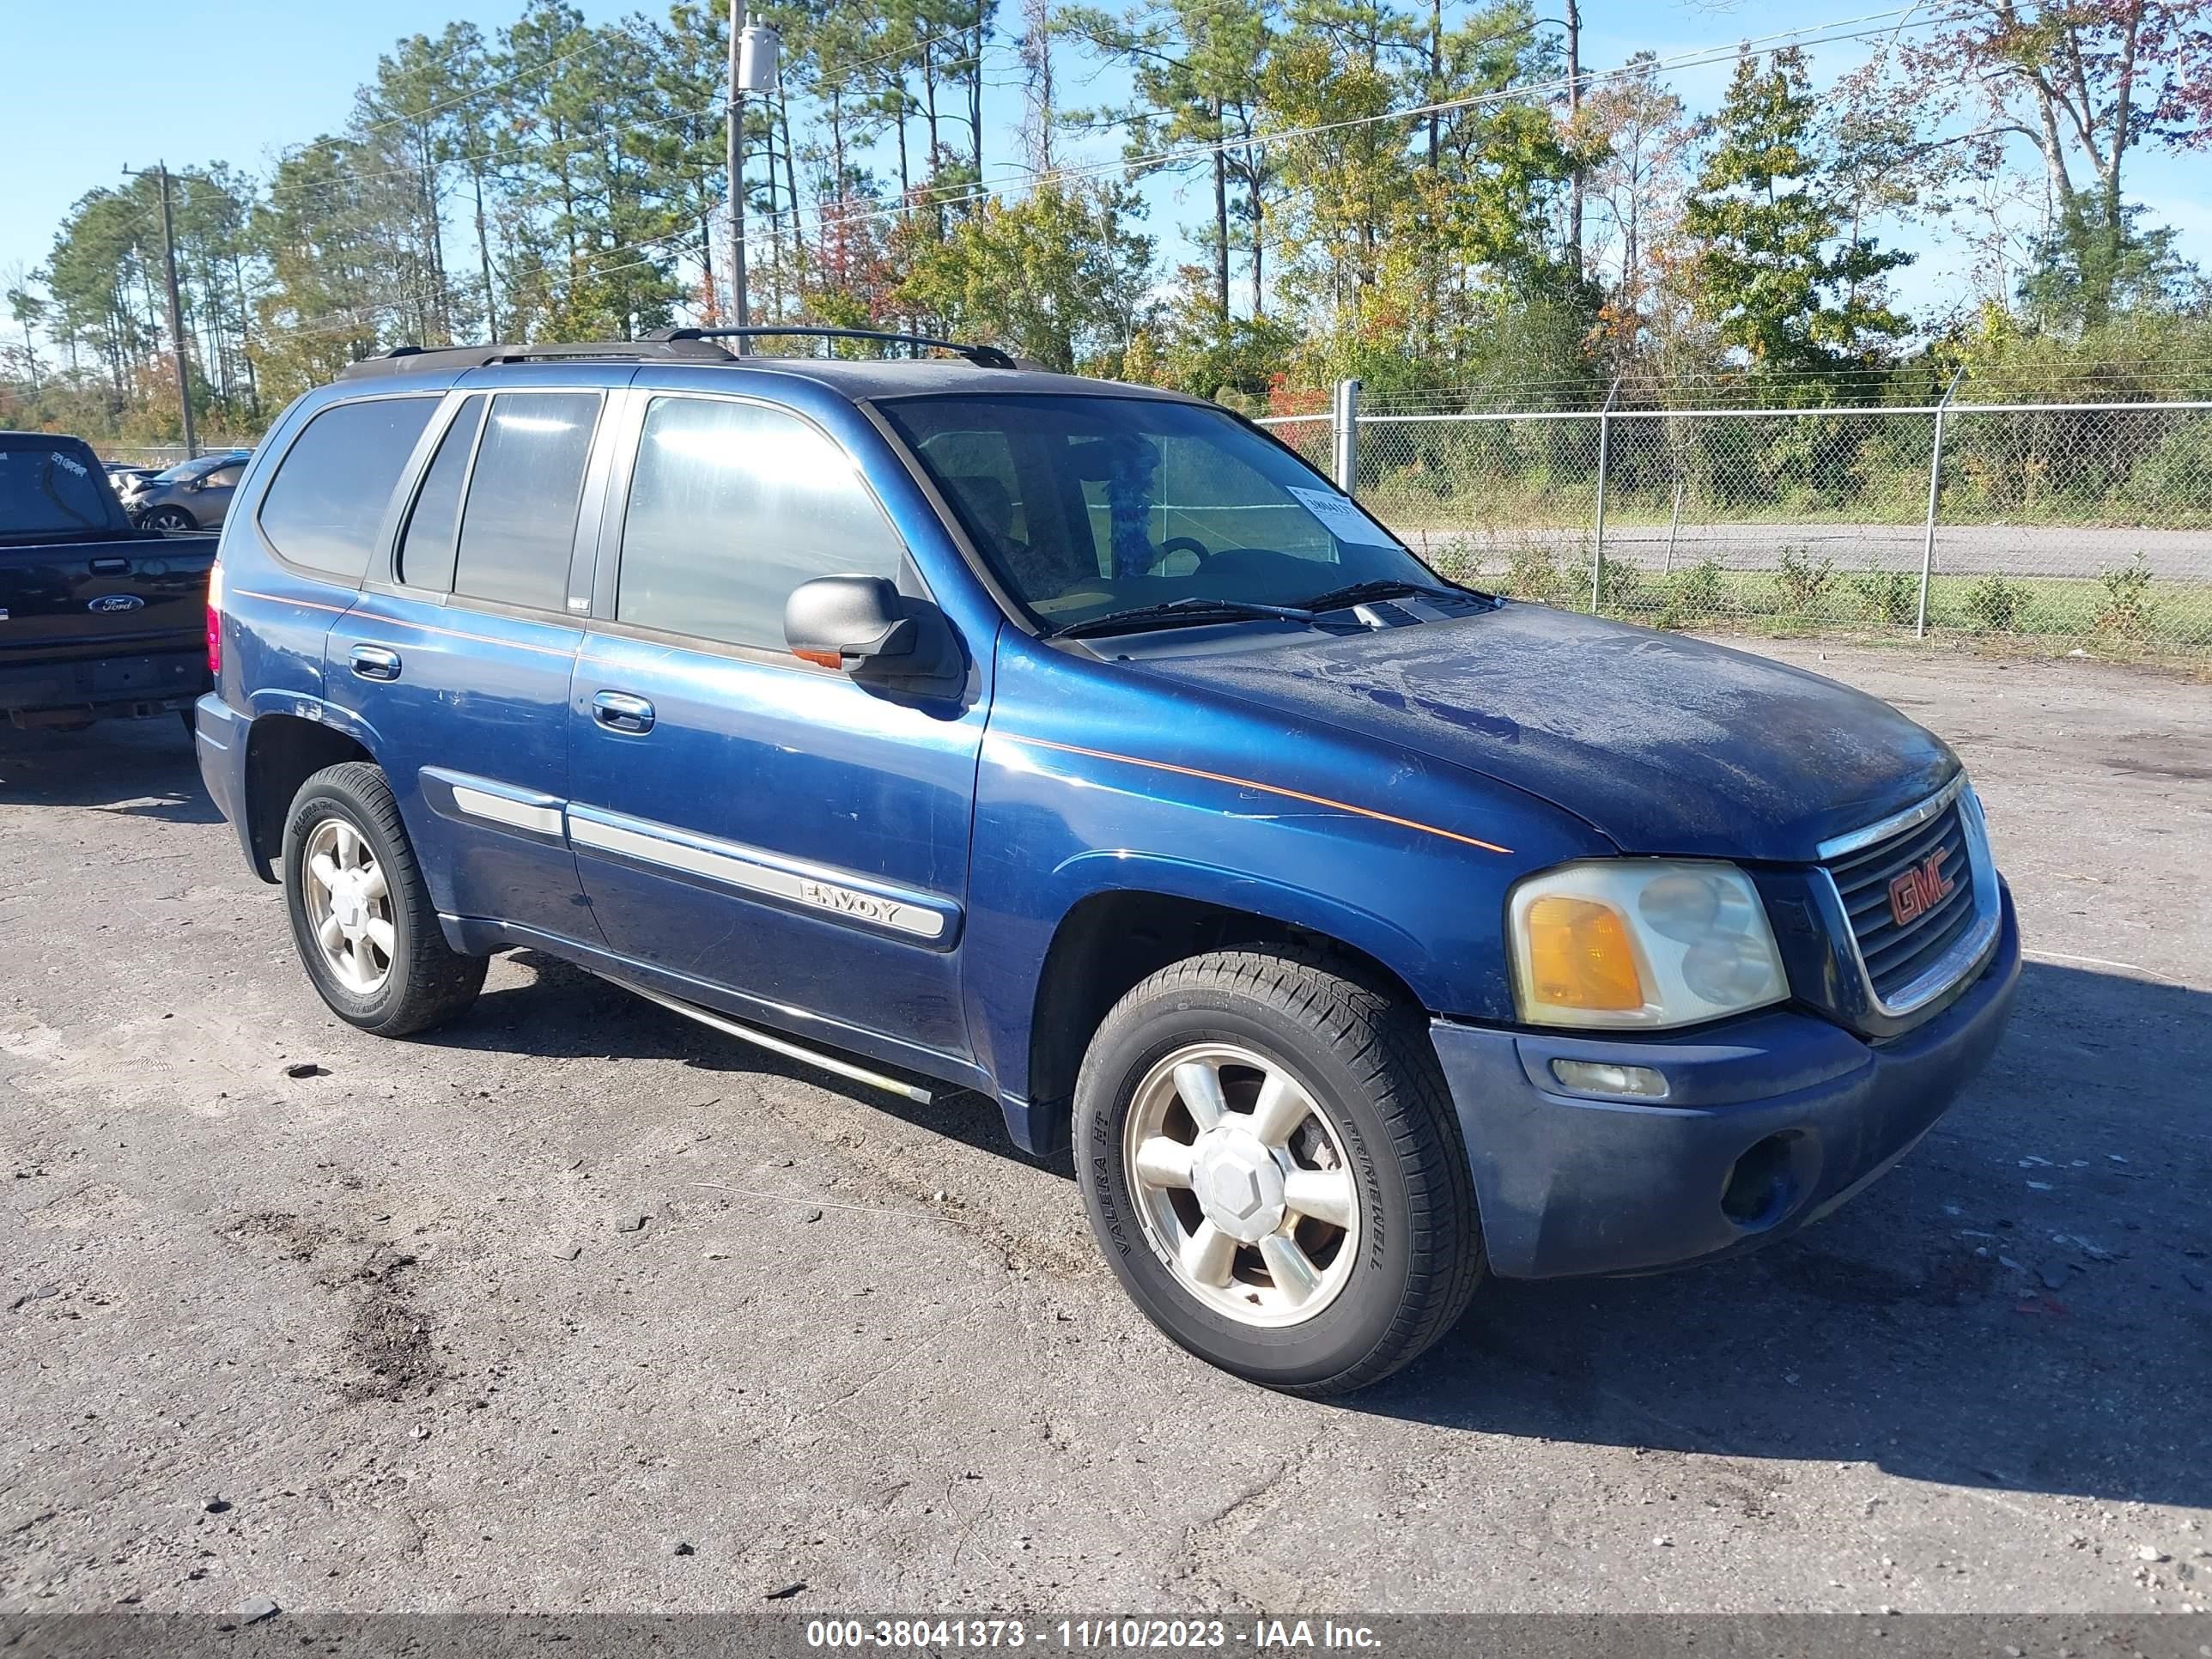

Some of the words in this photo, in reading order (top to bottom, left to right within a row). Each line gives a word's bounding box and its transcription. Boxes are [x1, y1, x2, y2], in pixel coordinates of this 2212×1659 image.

[102, 599, 132, 611] Ford
[799, 879, 901, 922] ENVOY
[1889, 846, 1954, 927] GMC
[1093, 1109, 1109, 1146] HT
[1093, 1156, 1132, 1257] VALERA
[1341, 1119, 1385, 1271] PRIMEWELL
